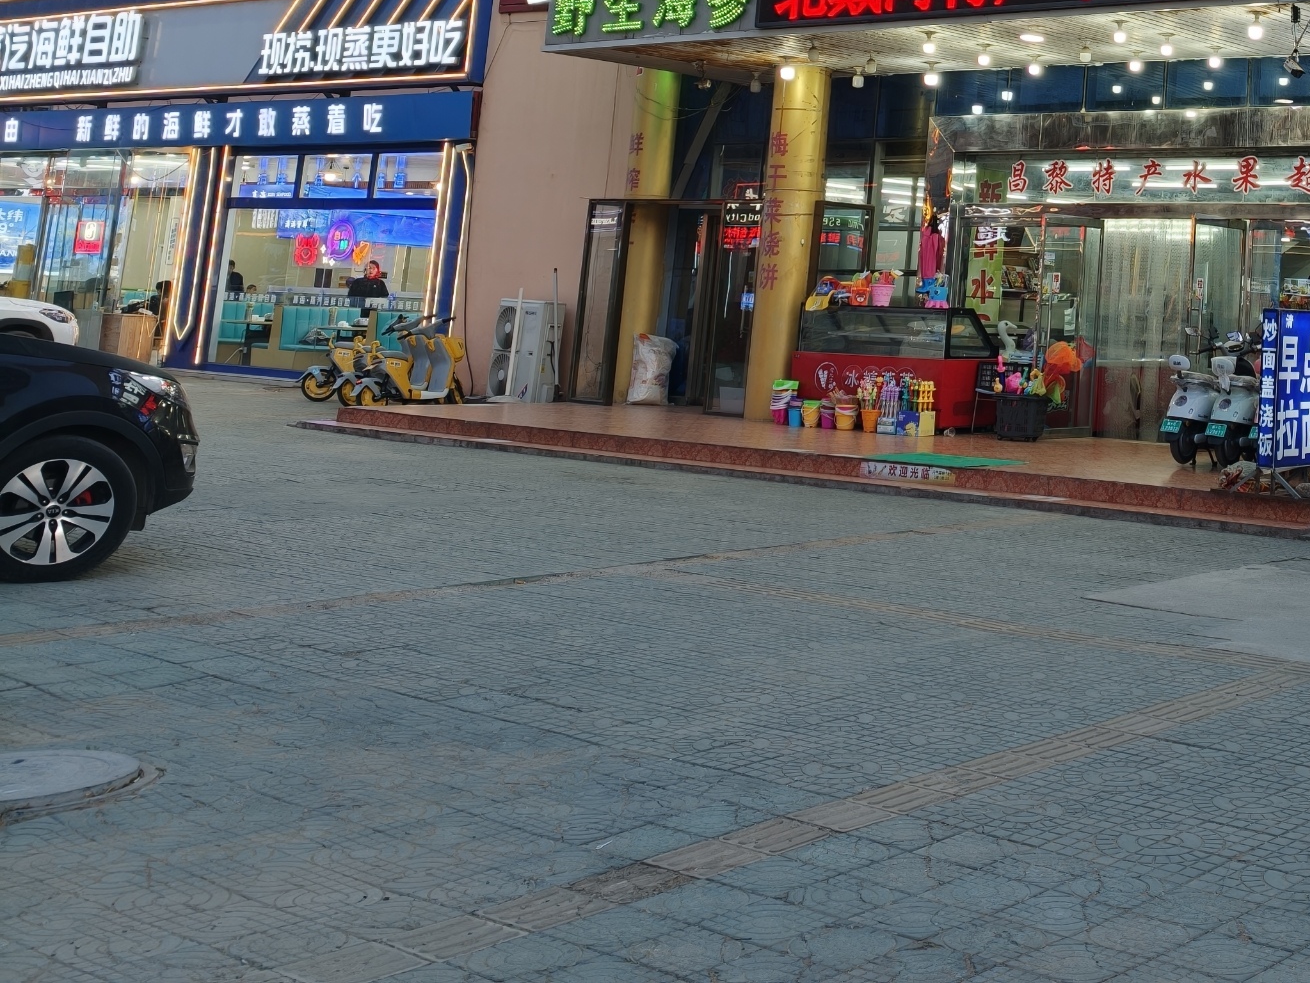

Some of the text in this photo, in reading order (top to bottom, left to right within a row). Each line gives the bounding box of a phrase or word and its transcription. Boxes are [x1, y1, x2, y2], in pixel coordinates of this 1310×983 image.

[76, 103, 384, 142] 新鲜的海鲜才敢蒸着吃
[1259, 318, 1278, 457] 炒面盖浇饭
[888, 464, 930, 480] 欢迎光临
